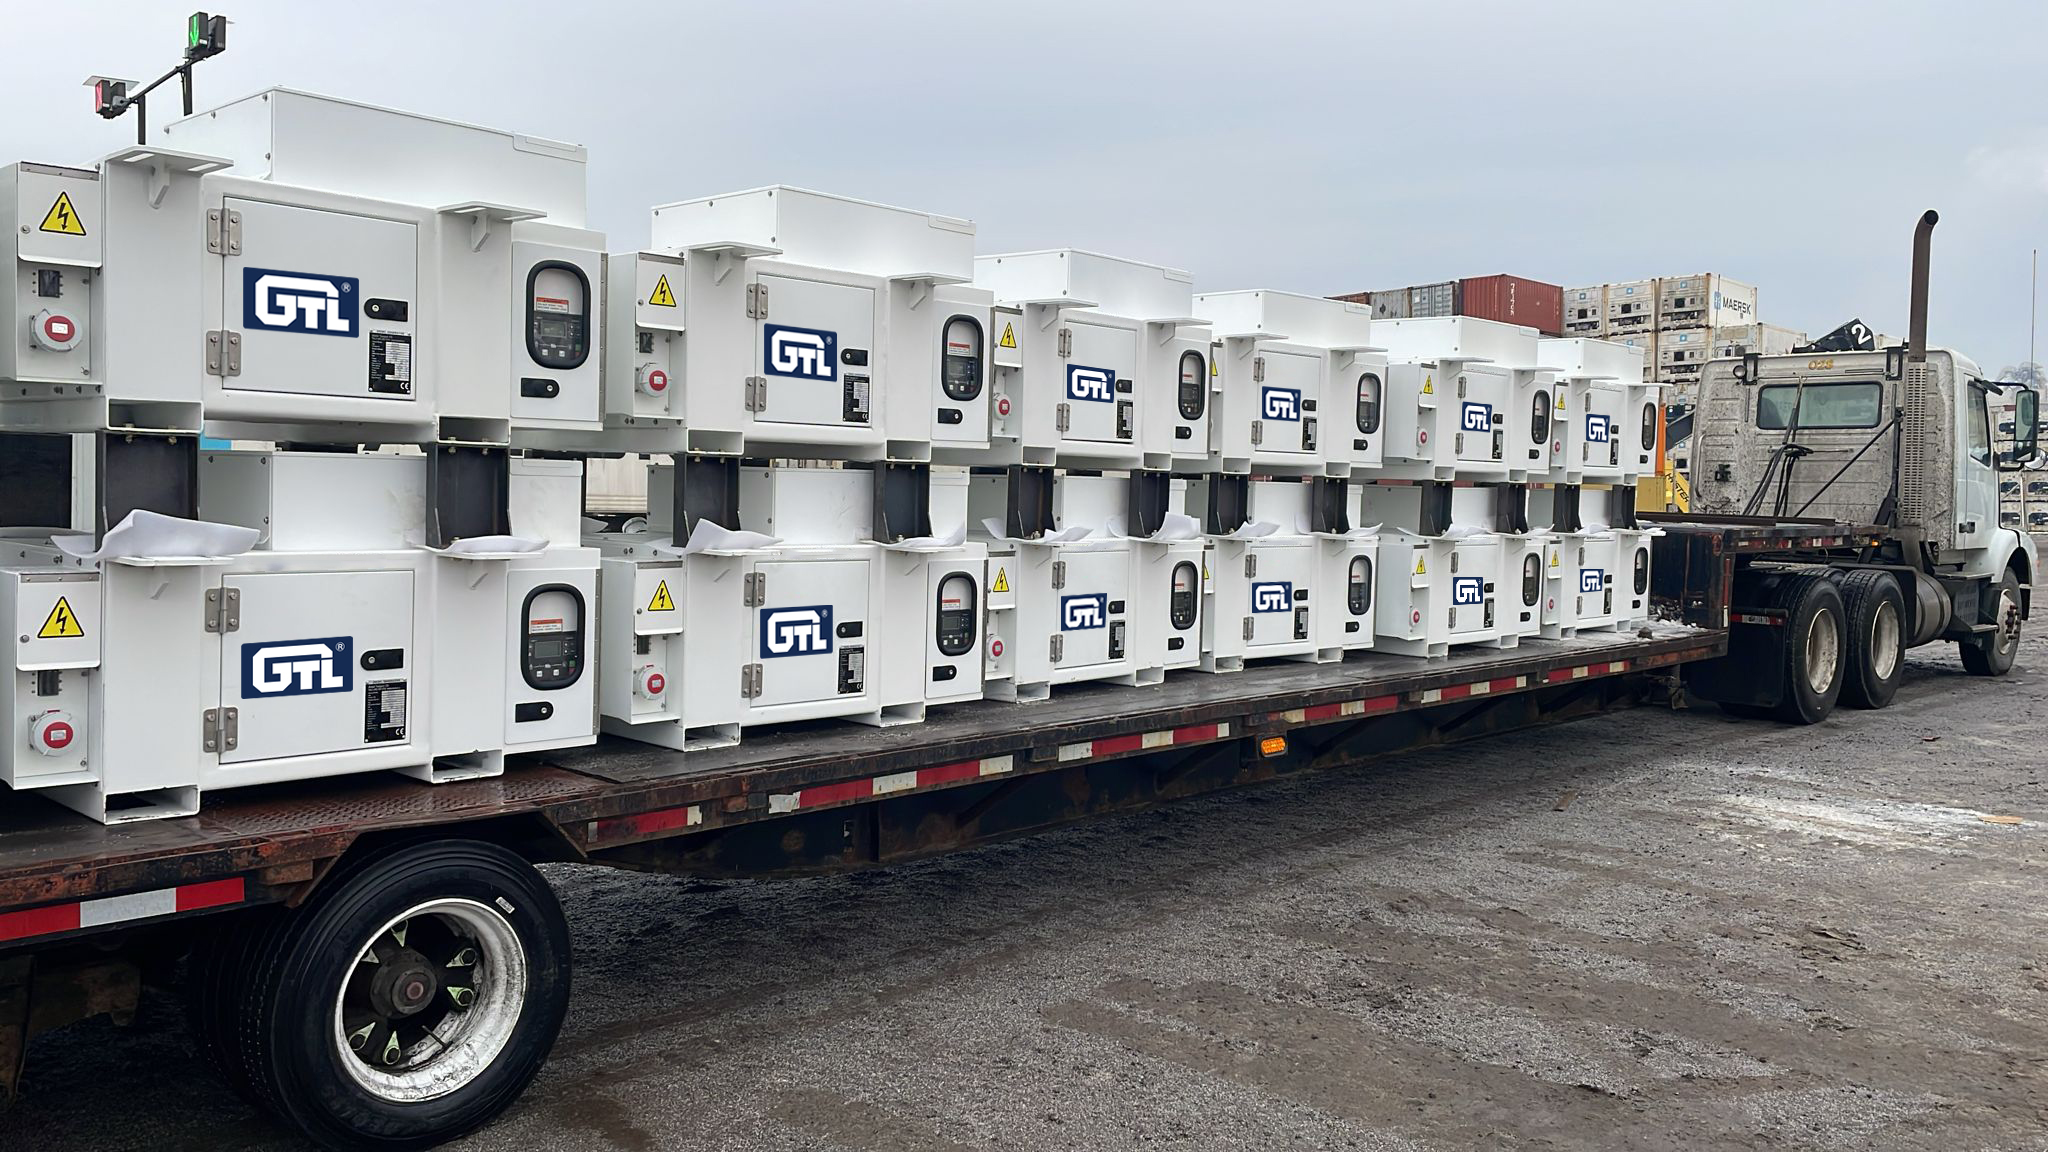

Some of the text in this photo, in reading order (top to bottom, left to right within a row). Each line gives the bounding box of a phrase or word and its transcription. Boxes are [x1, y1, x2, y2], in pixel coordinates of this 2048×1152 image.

[255, 275, 349, 331] GTL
[1722, 296, 1752, 315] MAERSK
[1851, 323, 1872, 345] 2
[771, 330, 832, 377] GTL
[1071, 368, 1111, 400] GTL
[1266, 390, 1299, 420] GTL
[1464, 404, 1490, 432] GTL
[1588, 416, 1607, 442] GTL
[1456, 579, 1481, 603] GTL
[1581, 570, 1602, 592] GTL
[1065, 597, 1103, 627] GTL
[1256, 584, 1289, 611] GTL
[768, 610, 827, 654] GTL
[252, 643, 345, 692] GTL
